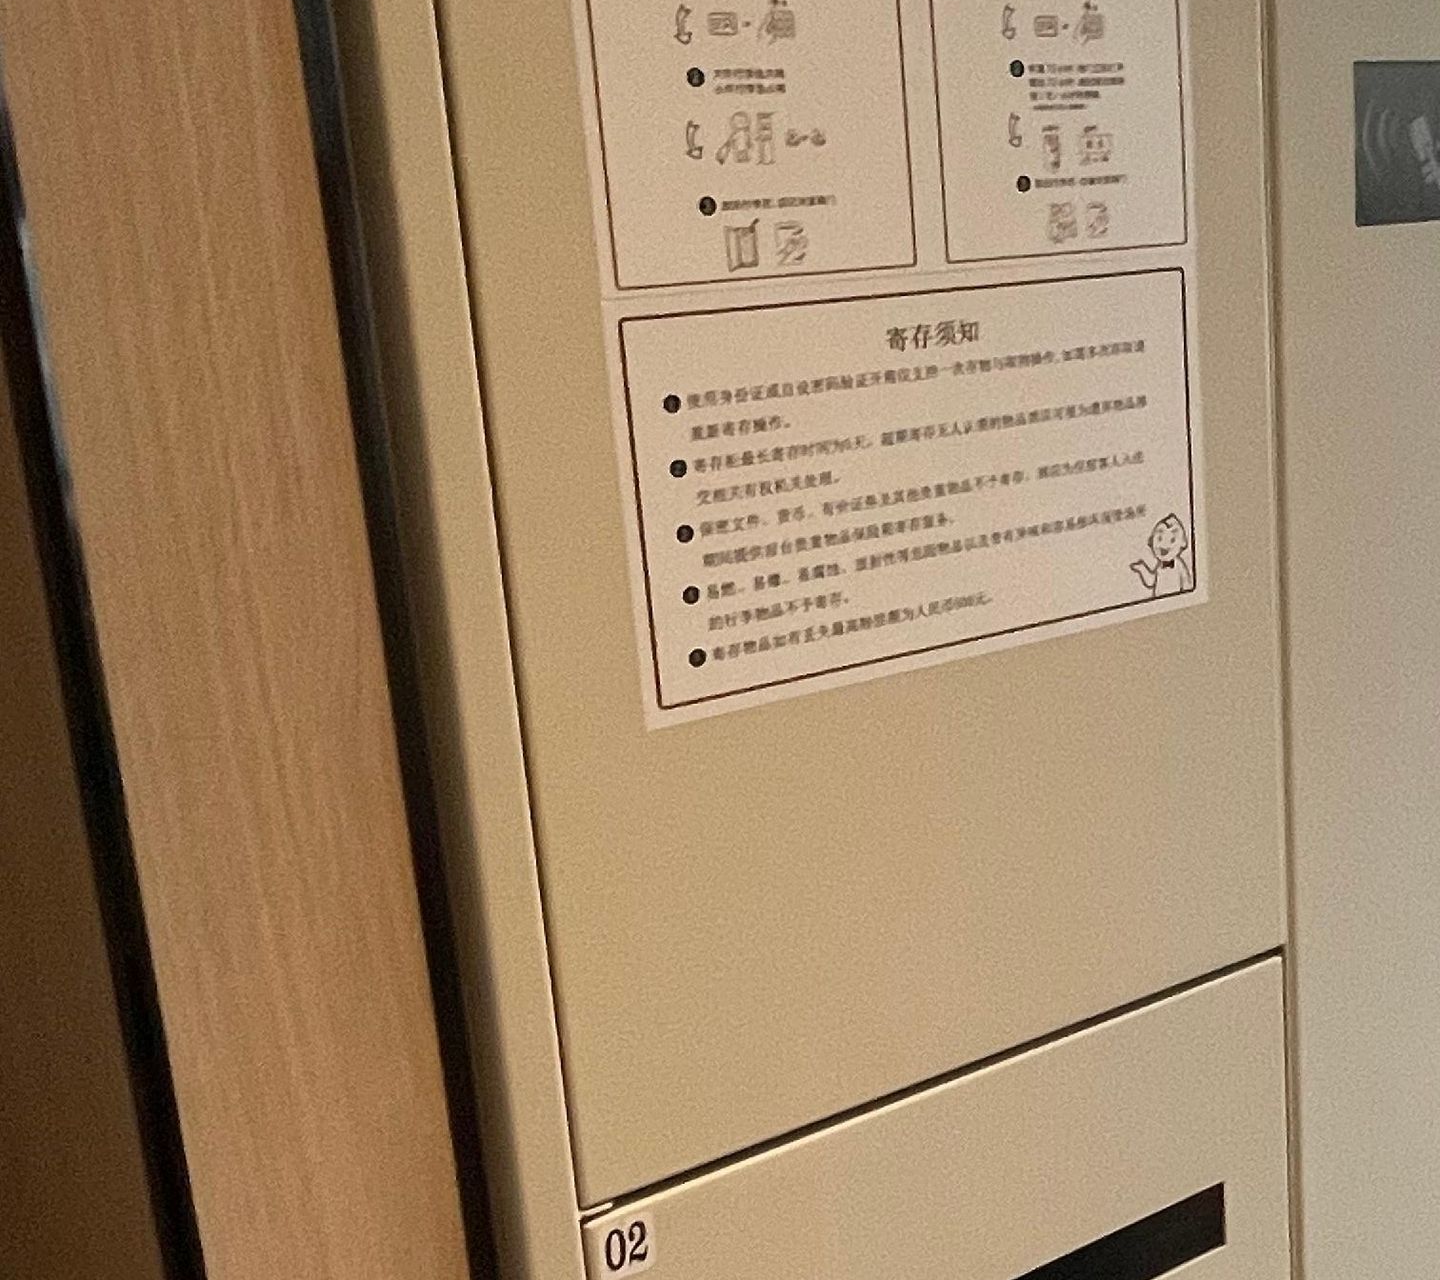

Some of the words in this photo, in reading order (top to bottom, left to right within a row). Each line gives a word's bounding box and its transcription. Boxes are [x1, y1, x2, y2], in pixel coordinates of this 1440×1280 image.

[885, 319, 980, 353] 寄存须知
[604, 1220, 649, 1273] 02
